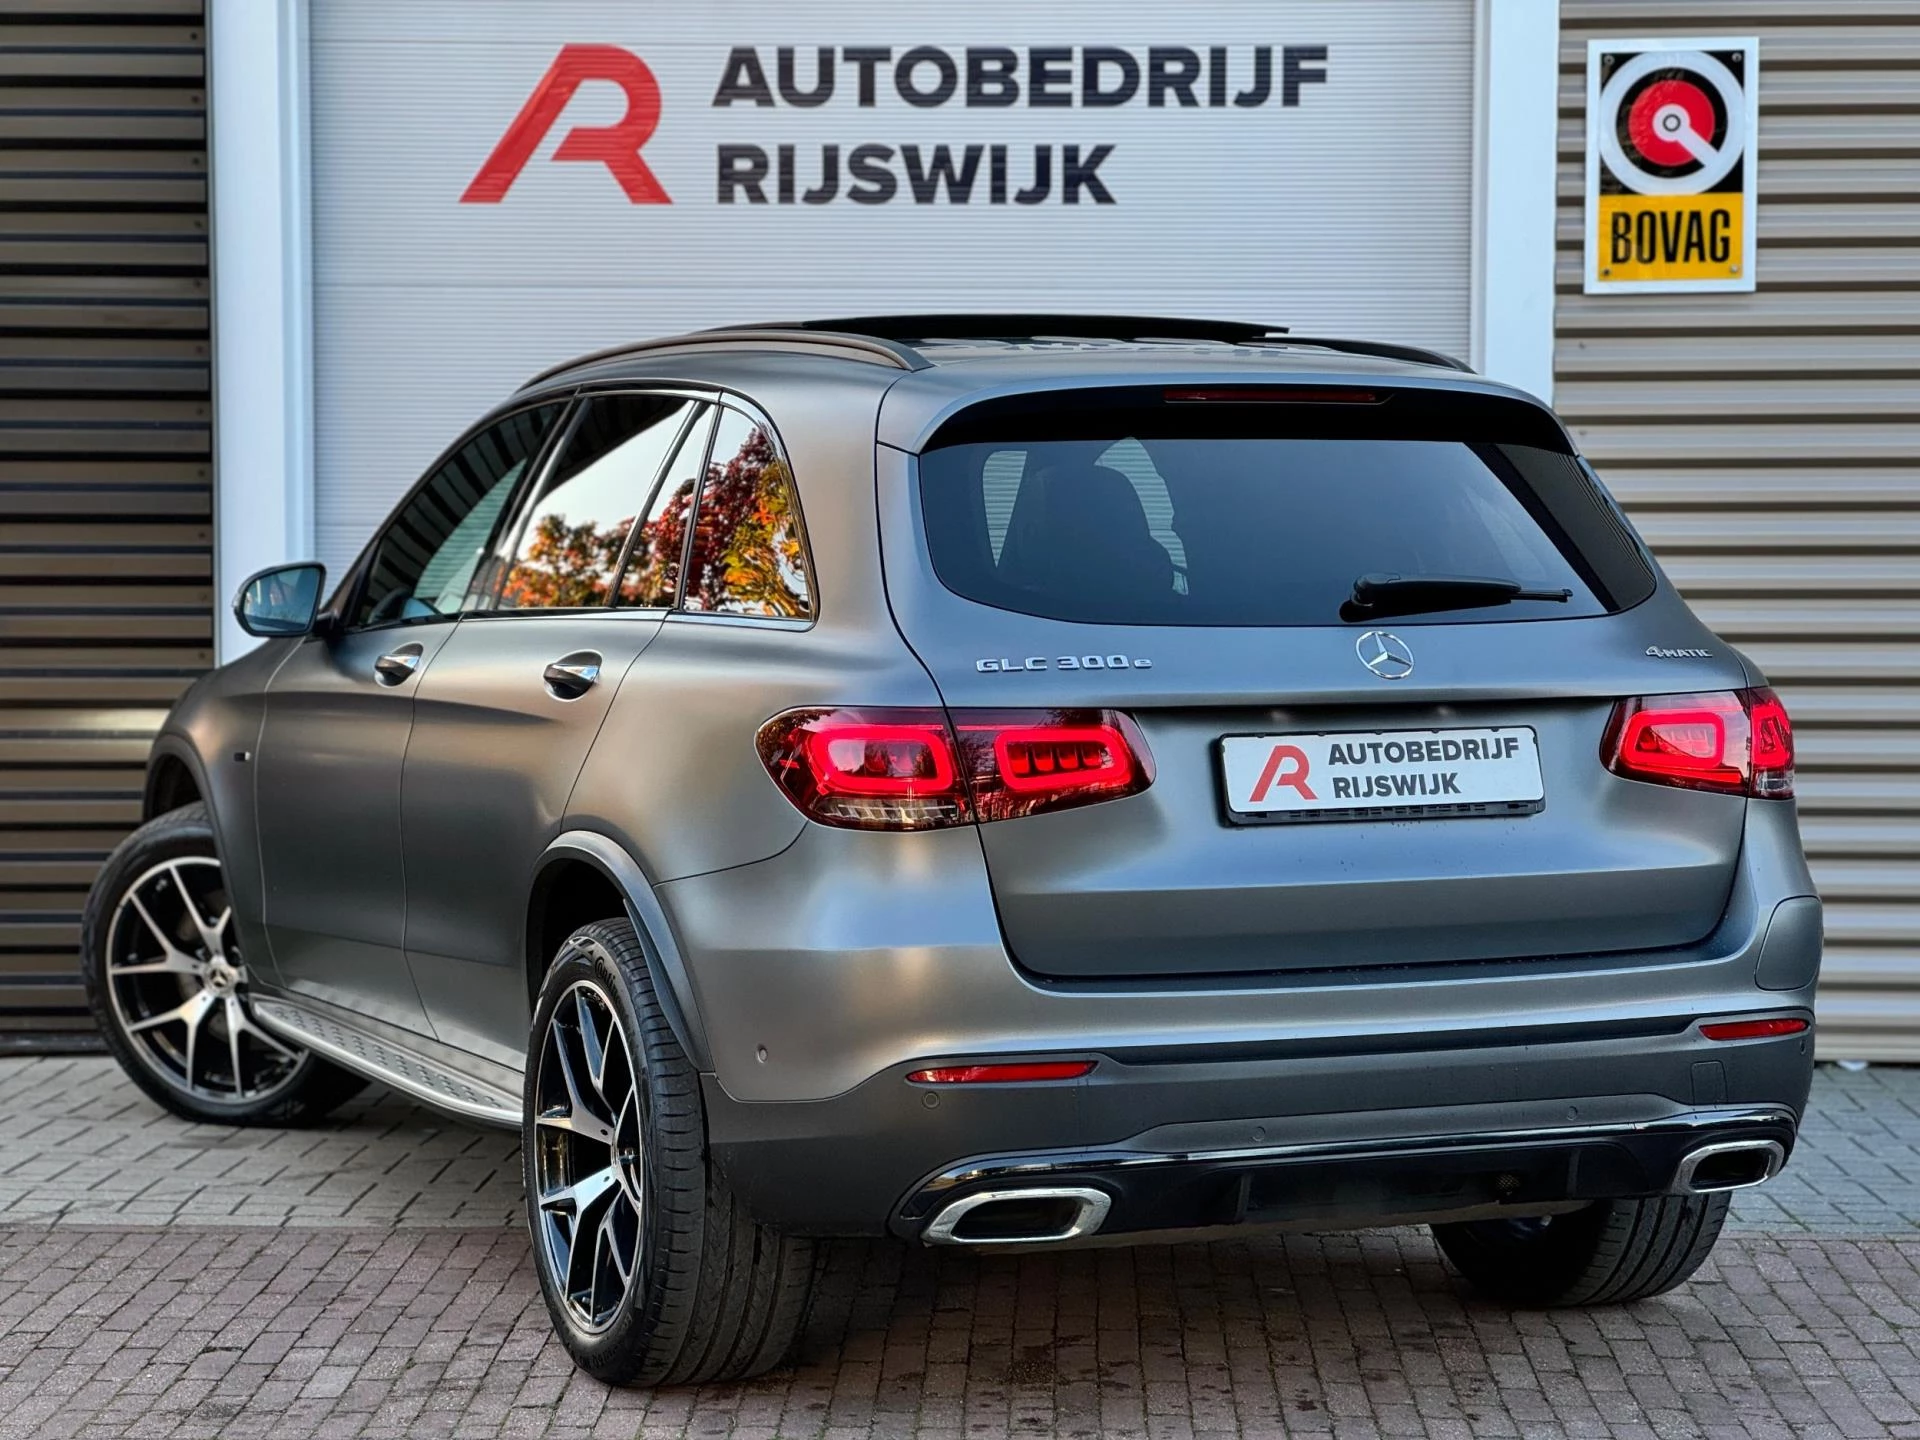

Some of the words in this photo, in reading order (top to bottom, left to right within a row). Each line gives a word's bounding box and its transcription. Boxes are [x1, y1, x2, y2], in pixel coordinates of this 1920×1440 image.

[712, 45, 1329, 108] AUTOBEDRIJF
[716, 144, 1118, 205] RIJSWIJK
[1611, 209, 1731, 264] BOVAG
[976, 657, 1048, 672] GLC
[1645, 645, 1713, 658] 4MATIC
[1328, 737, 1519, 765] AUTOBEDRIJF
[1332, 773, 1462, 799] RIJSWIJK
